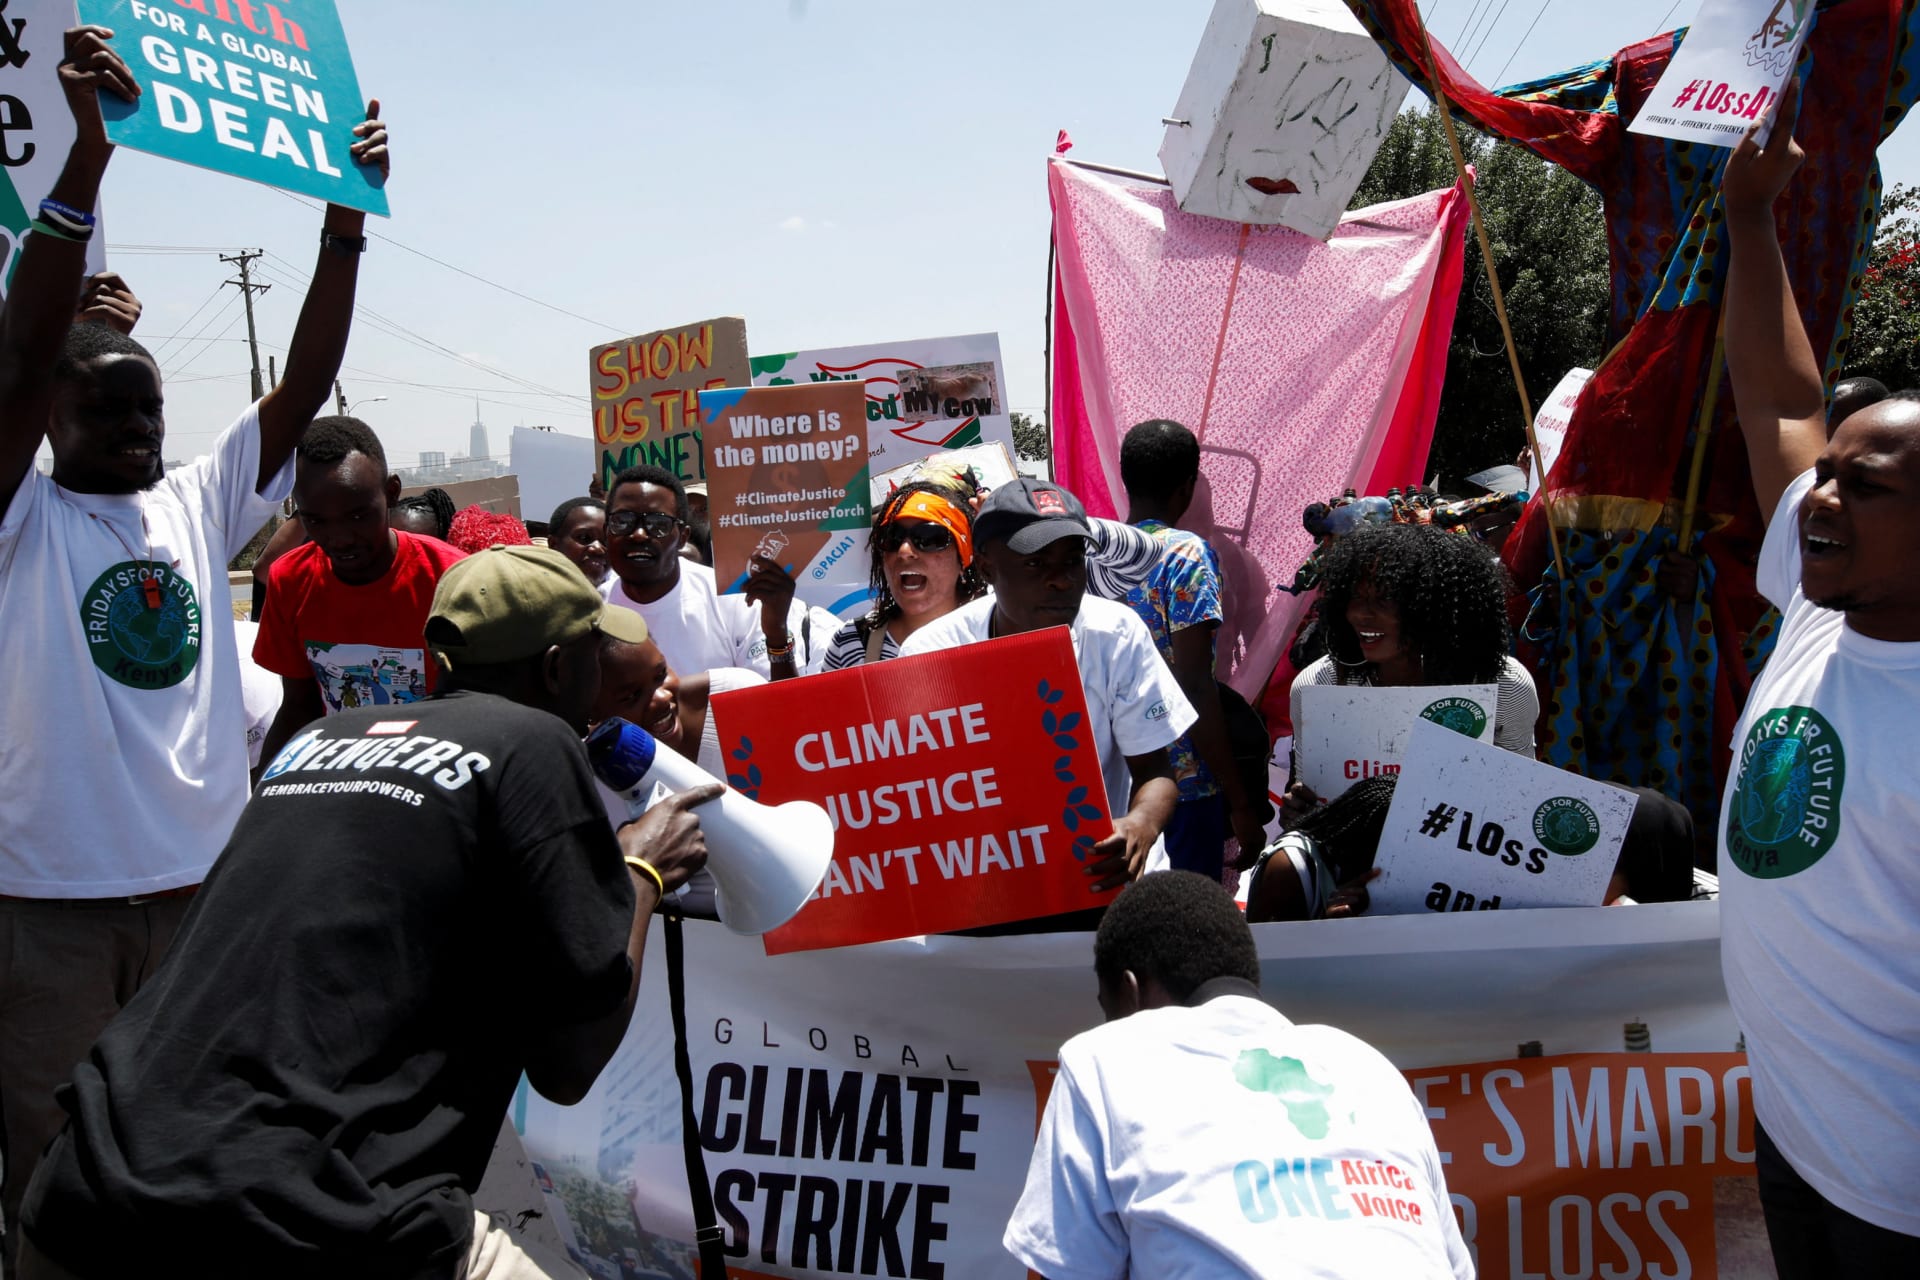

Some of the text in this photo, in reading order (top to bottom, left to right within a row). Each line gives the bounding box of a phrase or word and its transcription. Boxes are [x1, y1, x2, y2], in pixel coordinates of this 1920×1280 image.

[131, 0, 318, 80] FOR A GLOBAL
[140, 35, 329, 124] GREEN
[152, 80, 342, 178] DEAL
[596, 324, 713, 400] SHOW
[595, 378, 726, 445] US TH
[729, 410, 841, 439] Where is
[714, 435, 859, 468] the money?
[718, 504, 865, 528] #ClimateJusticeTorch
[735, 487, 846, 507] #ClimateJustice
[751, 539, 784, 573] PCJA
[811, 535, 856, 580] @PACJA1
[89, 568, 199, 647] FRIDAYS FOR FUTURE
[113, 657, 182, 686] Kenya
[793, 702, 991, 773] CLIMATE
[1430, 700, 1484, 721] FOR FUTURE
[261, 780, 425, 806] #EMBRACEYOURPOWERS
[824, 767, 1003, 834] JUSTICE
[1344, 759, 1401, 780] Clim
[1734, 716, 1789, 792] FRIDAYS
[1799, 743, 1834, 847] FUTURE
[1535, 799, 1598, 839] FRIDAYS FOR FUTURE
[1729, 816, 1779, 872] Kenya
[809, 824, 1052, 901] AN'T WAIT
[714, 1017, 969, 1072] GLOBAL
[700, 1062, 981, 1170] CLIMATE
[1552, 1066, 1757, 1169] MARC
[713, 1168, 950, 1280] STRIKE
[1232, 1157, 1416, 1224] ONE Africa
[1350, 1193, 1423, 1226] Voice
[1507, 1190, 1693, 1280] LOSS
